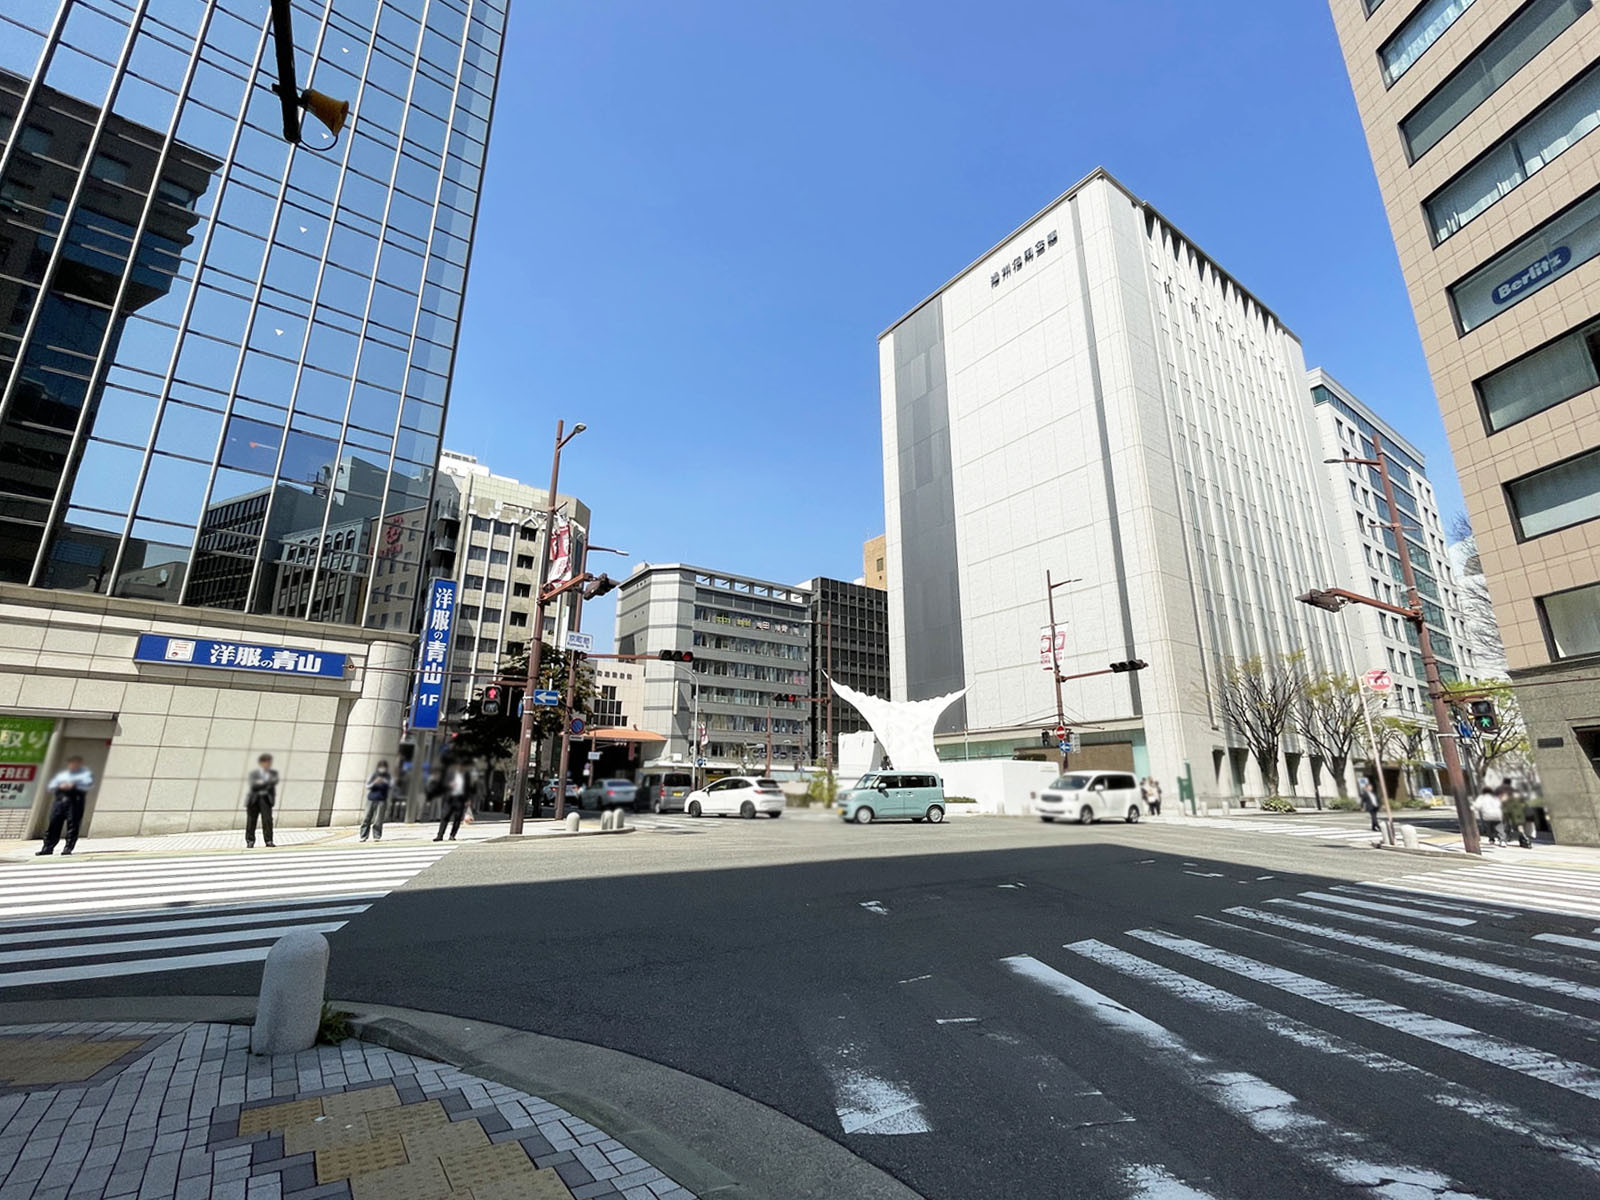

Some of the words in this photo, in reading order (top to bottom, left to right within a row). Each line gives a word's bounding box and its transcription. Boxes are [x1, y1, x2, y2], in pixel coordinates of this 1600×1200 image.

[1498, 254, 1562, 299] Berlitz
[423, 587, 454, 684] 洋服の青山
[210, 644, 322, 673] 洋服の青山
[420, 694, 439, 707] 1F
